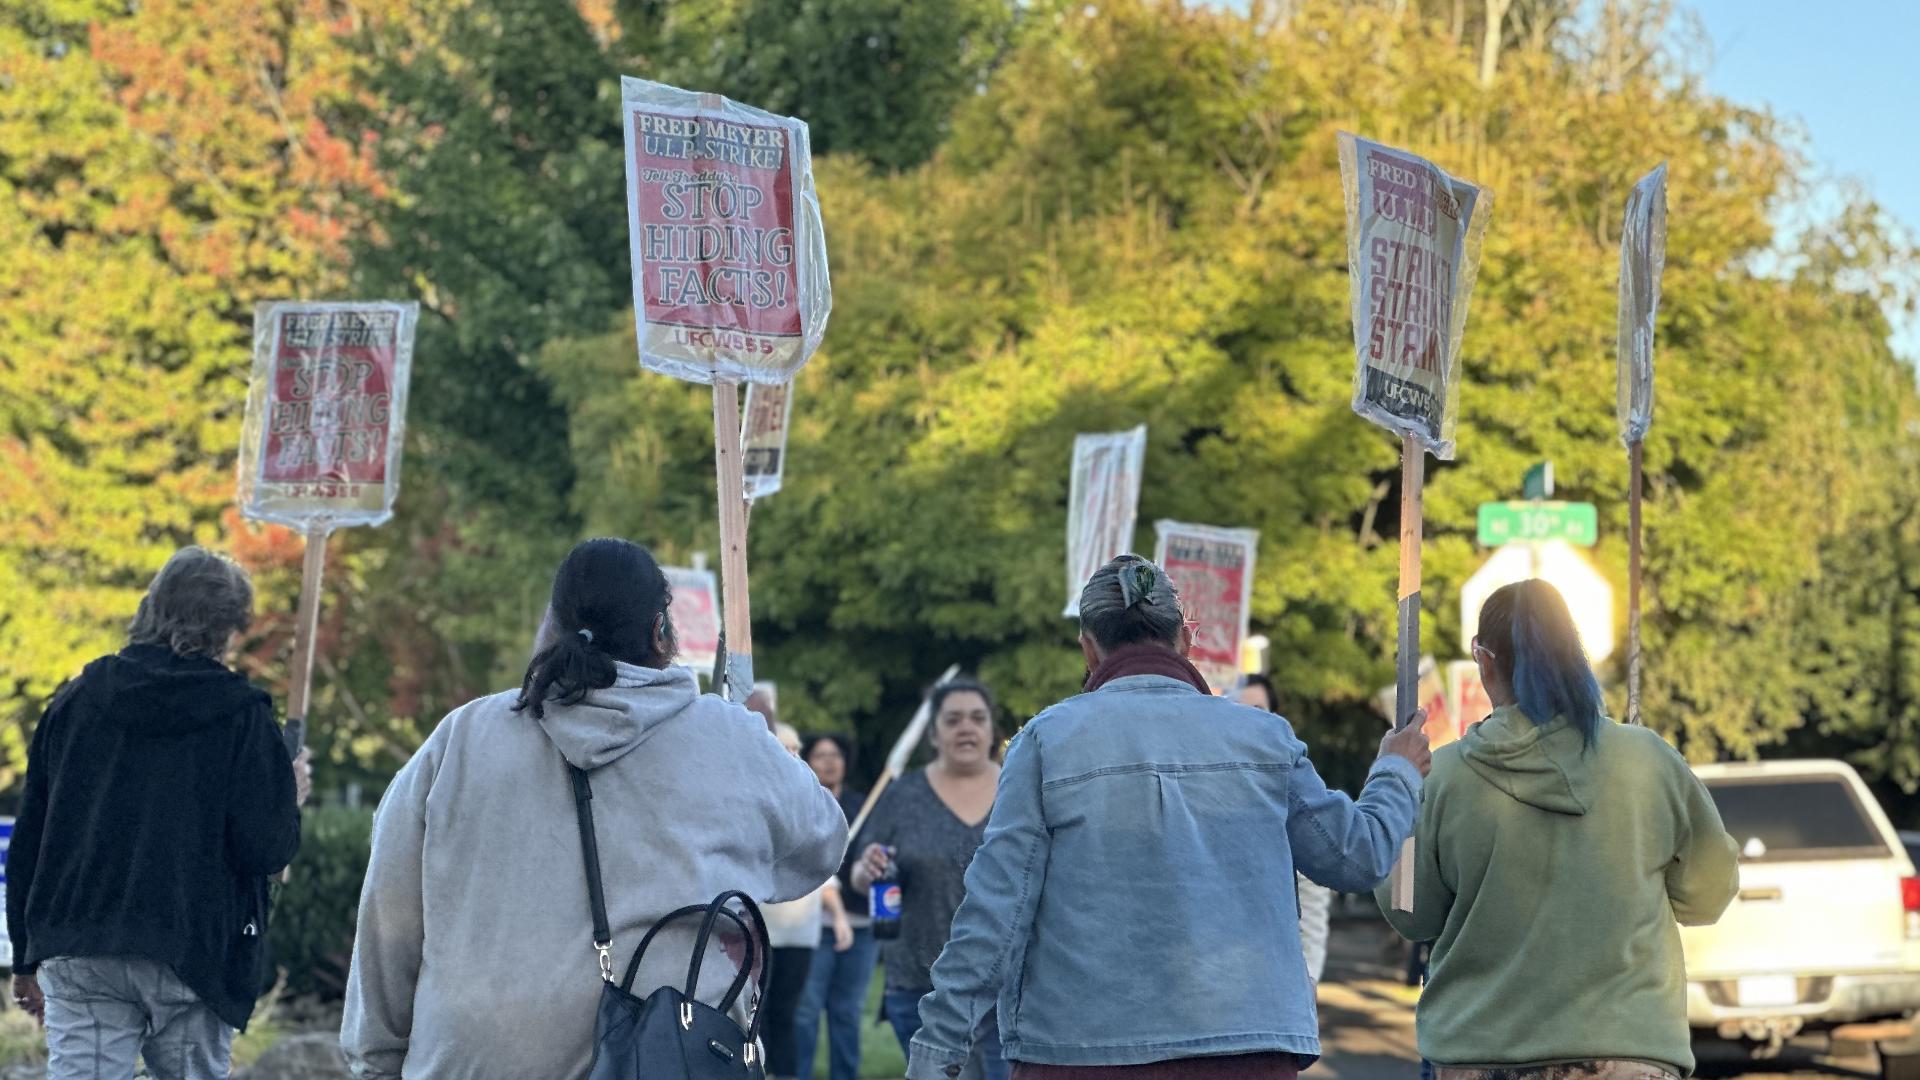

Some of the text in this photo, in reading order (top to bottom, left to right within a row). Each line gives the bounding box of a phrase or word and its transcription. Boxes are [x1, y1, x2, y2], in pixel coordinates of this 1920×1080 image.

[639, 114, 785, 148] FRED MEYER
[704, 140, 784, 169] STRIKE!
[1367, 157, 1418, 190] FRED
[661, 181, 764, 221] STOP
[645, 223, 793, 267] HIDING
[659, 266, 788, 309] FACTS!
[674, 328, 774, 355] UFCW555
[1370, 312, 1439, 375] STRIK
[291, 361, 375, 399] STOP
[271, 393, 391, 433] HING
[276, 427, 383, 467] FATS!
